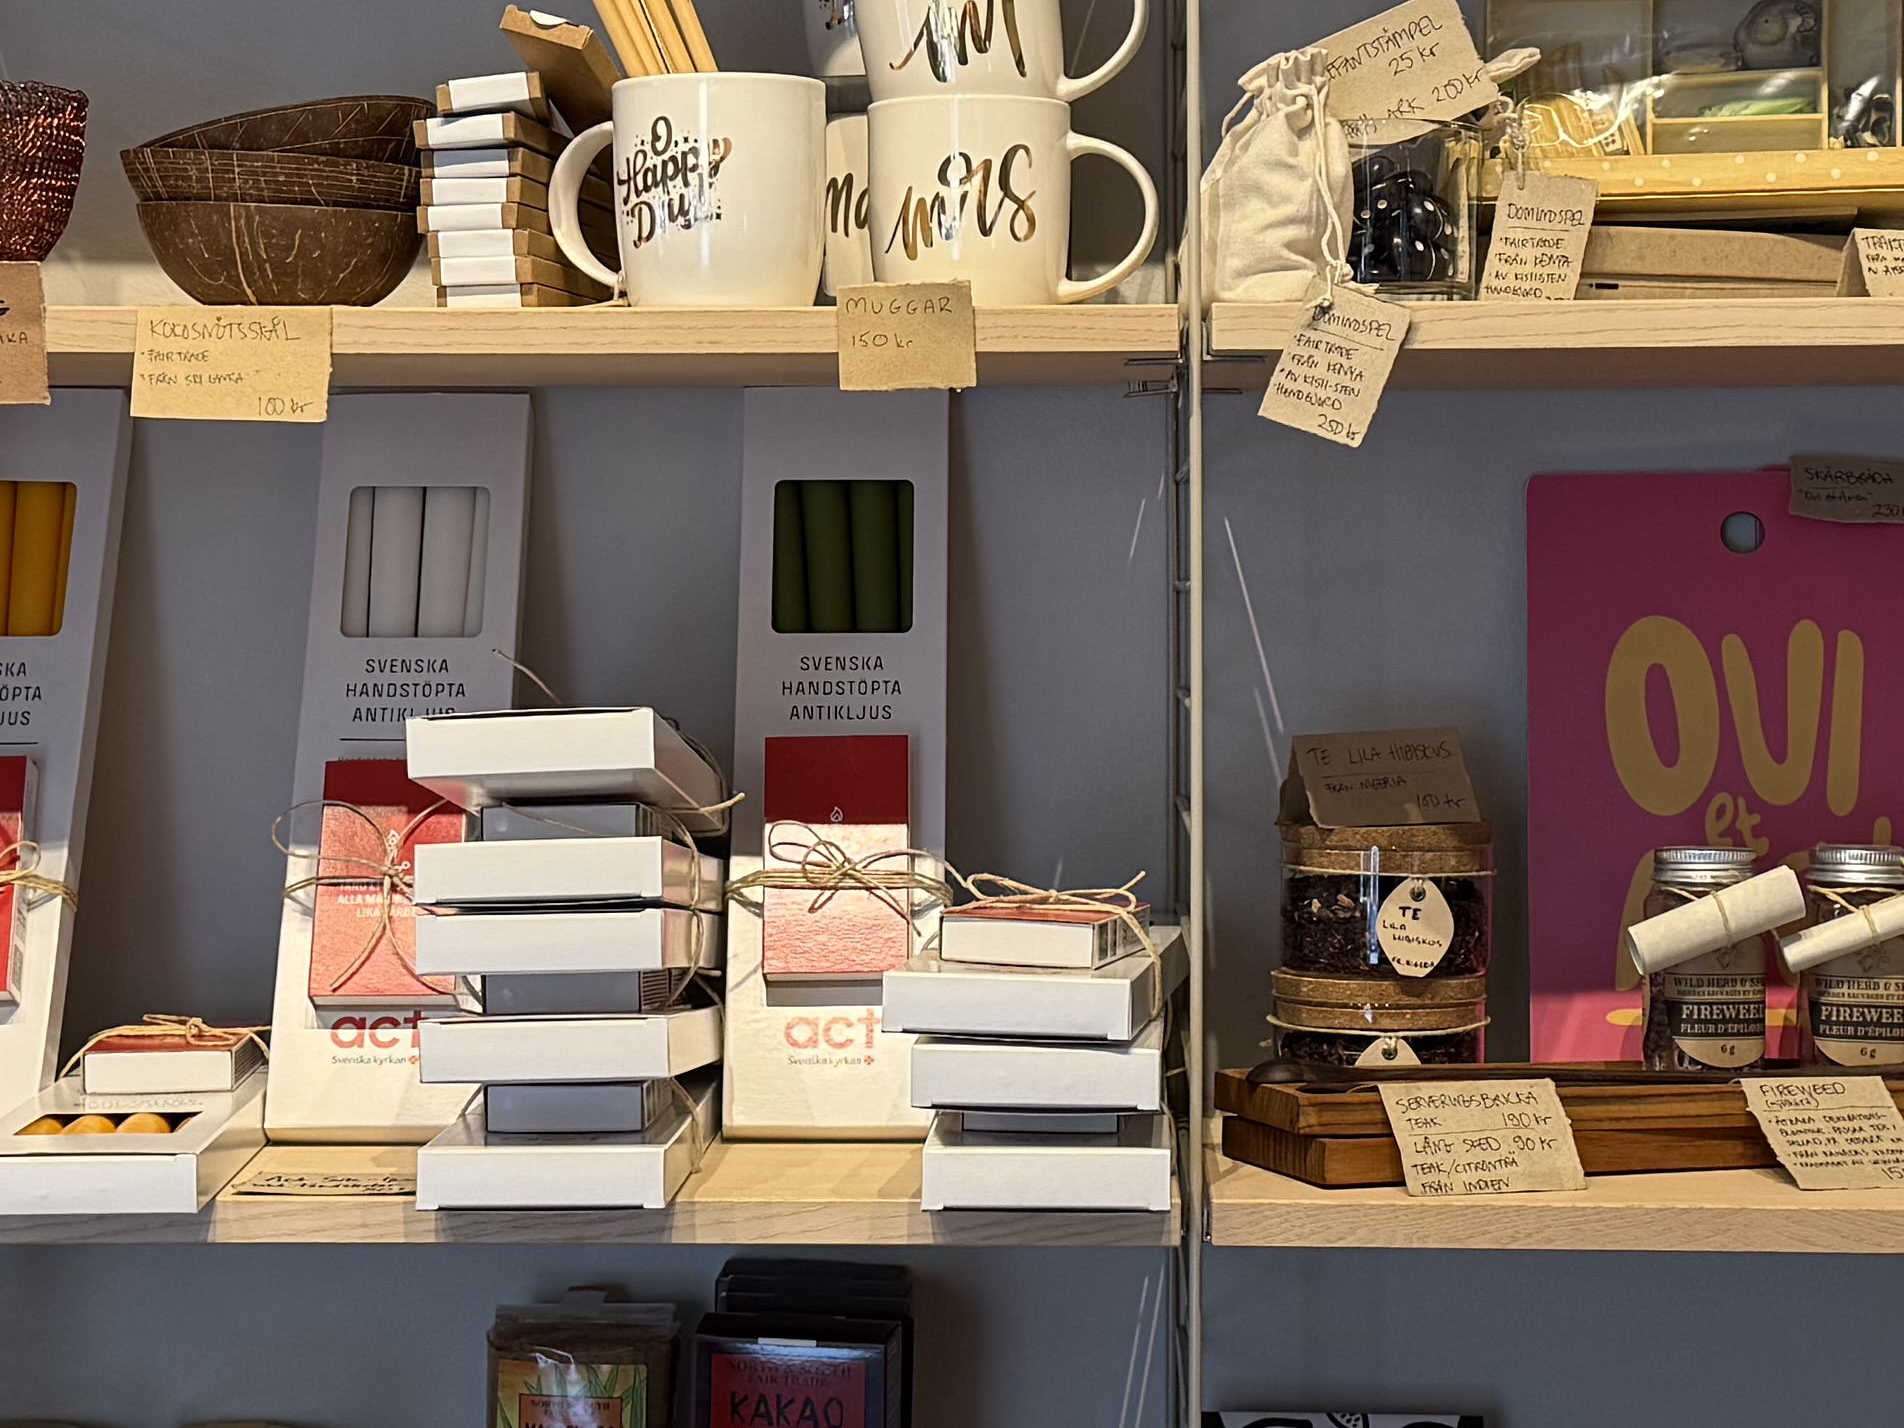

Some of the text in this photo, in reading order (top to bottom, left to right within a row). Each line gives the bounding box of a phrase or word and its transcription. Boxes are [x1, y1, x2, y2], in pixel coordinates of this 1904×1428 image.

[615, 136, 733, 207] Happy
[844, 295, 953, 318] MUGGAR
[850, 331, 914, 350] 150 kr
[1603, 612, 1866, 817] OVI
[1704, 790, 1770, 857] et
